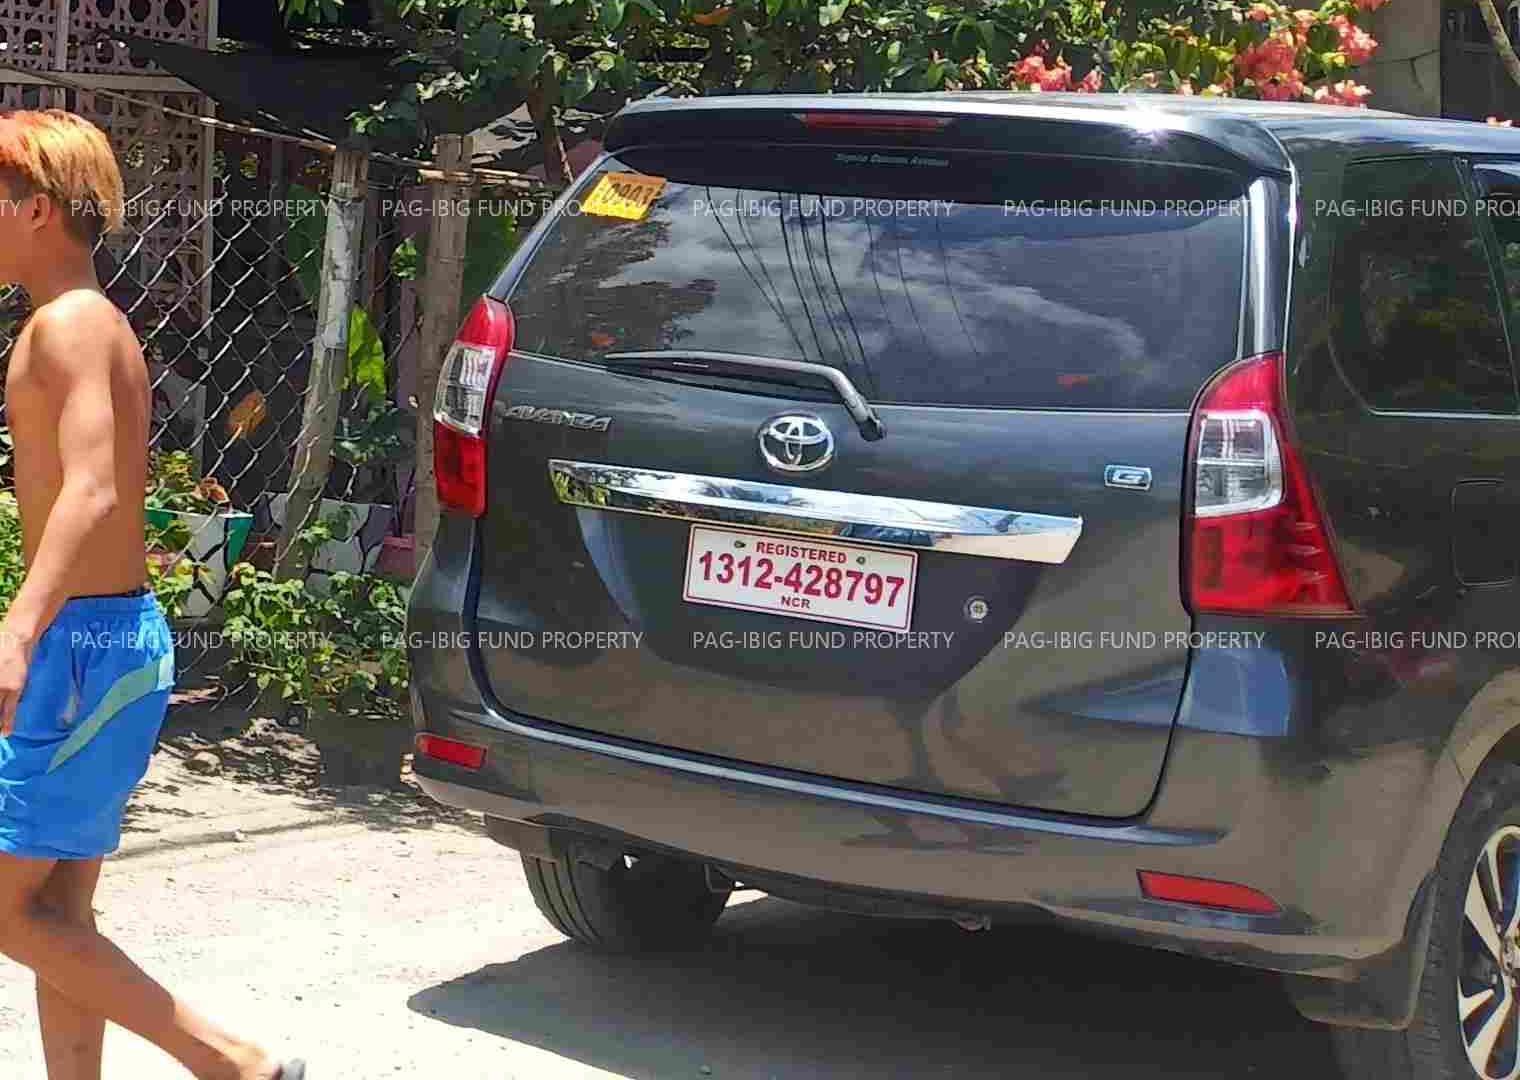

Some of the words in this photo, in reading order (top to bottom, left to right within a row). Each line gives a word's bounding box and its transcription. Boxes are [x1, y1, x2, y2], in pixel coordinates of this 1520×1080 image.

[755, 541, 848, 565] REGISTERED
[698, 550, 906, 608] 1312-428797
[780, 595, 811, 610] NCR
